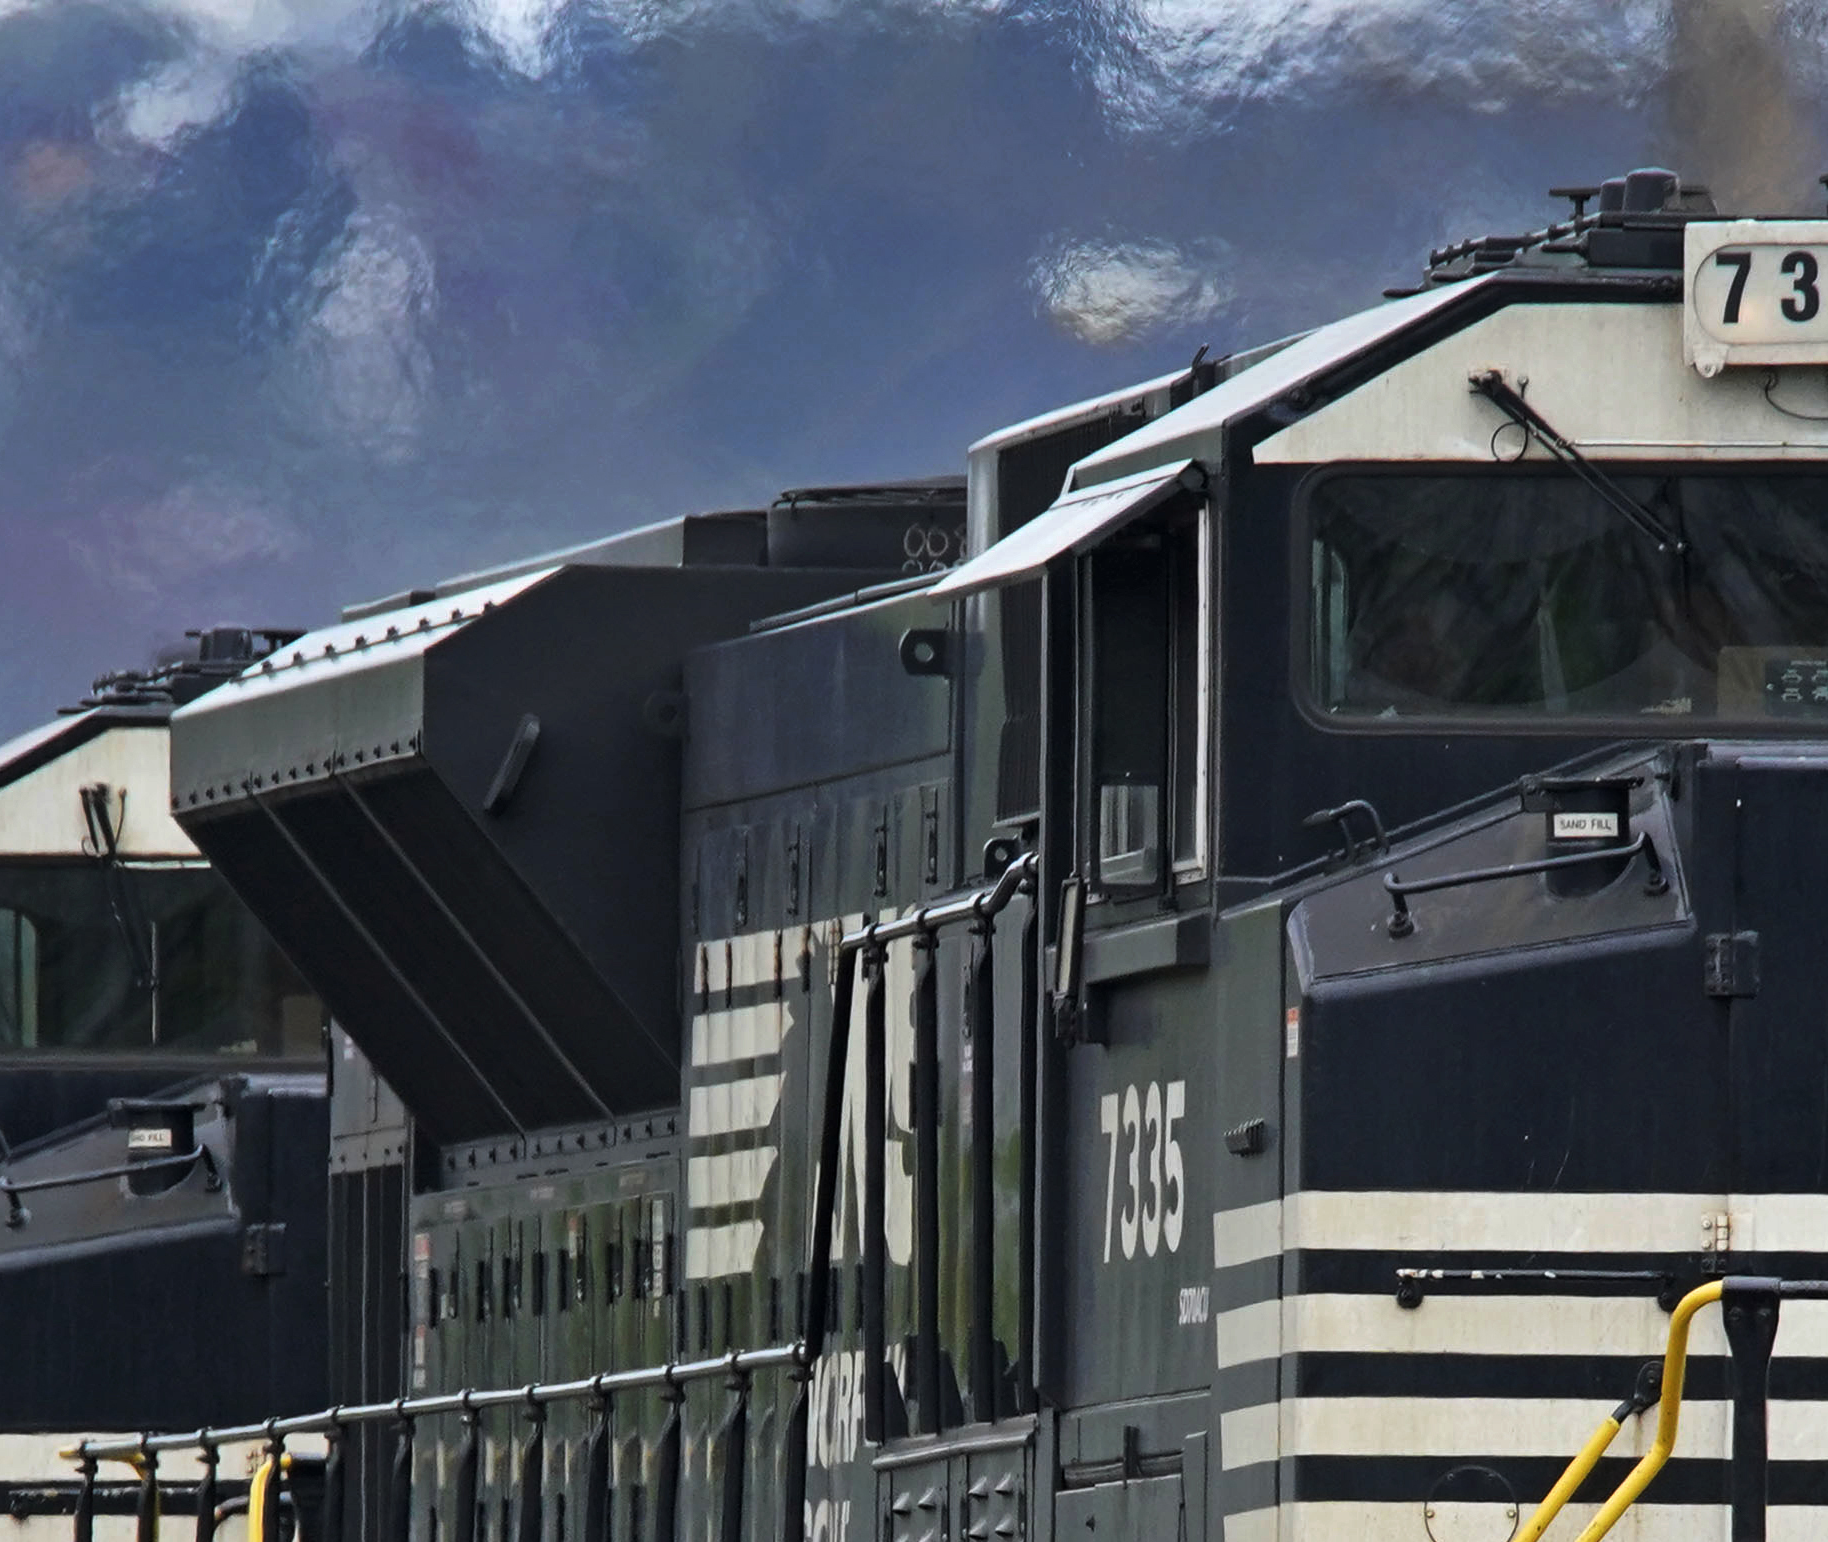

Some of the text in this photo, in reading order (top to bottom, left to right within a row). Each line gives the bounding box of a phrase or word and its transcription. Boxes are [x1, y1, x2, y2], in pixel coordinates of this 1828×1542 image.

[1560, 819, 1612, 831] SAND FILL
[1100, 1080, 1186, 1264] 7335
